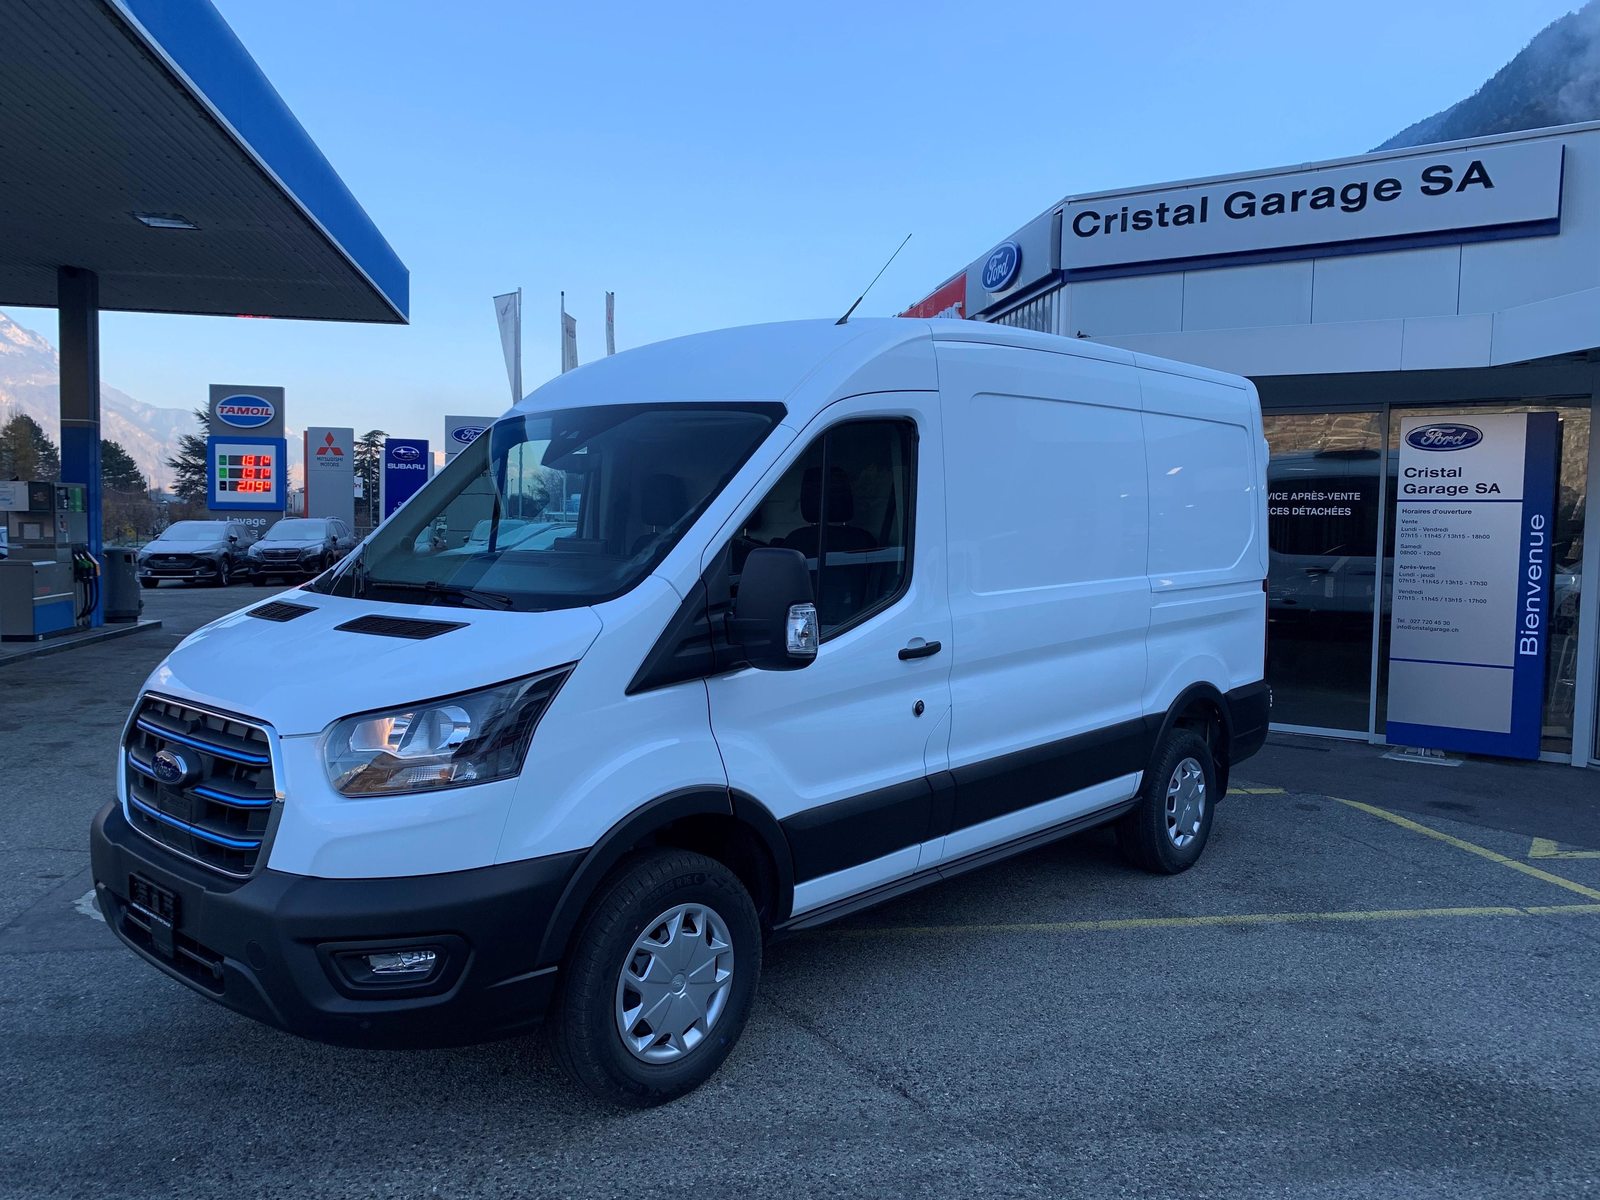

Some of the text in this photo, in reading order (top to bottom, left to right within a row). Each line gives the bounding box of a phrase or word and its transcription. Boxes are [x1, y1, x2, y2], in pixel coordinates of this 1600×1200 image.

[1072, 160, 1495, 238] Cristal Garage SA
[986, 251, 1010, 285] Ford
[218, 406, 272, 416] TAMOIL
[1421, 428, 1467, 445] Ford
[1404, 467, 1462, 478] Cristal
[1268, 491, 1361, 500] VICE APRÈS-VENTE
[1403, 483, 1501, 496] Garage SA
[1268, 506, 1351, 515] CES DÉTACHÉES
[1519, 514, 1545, 655] Bienvenue
